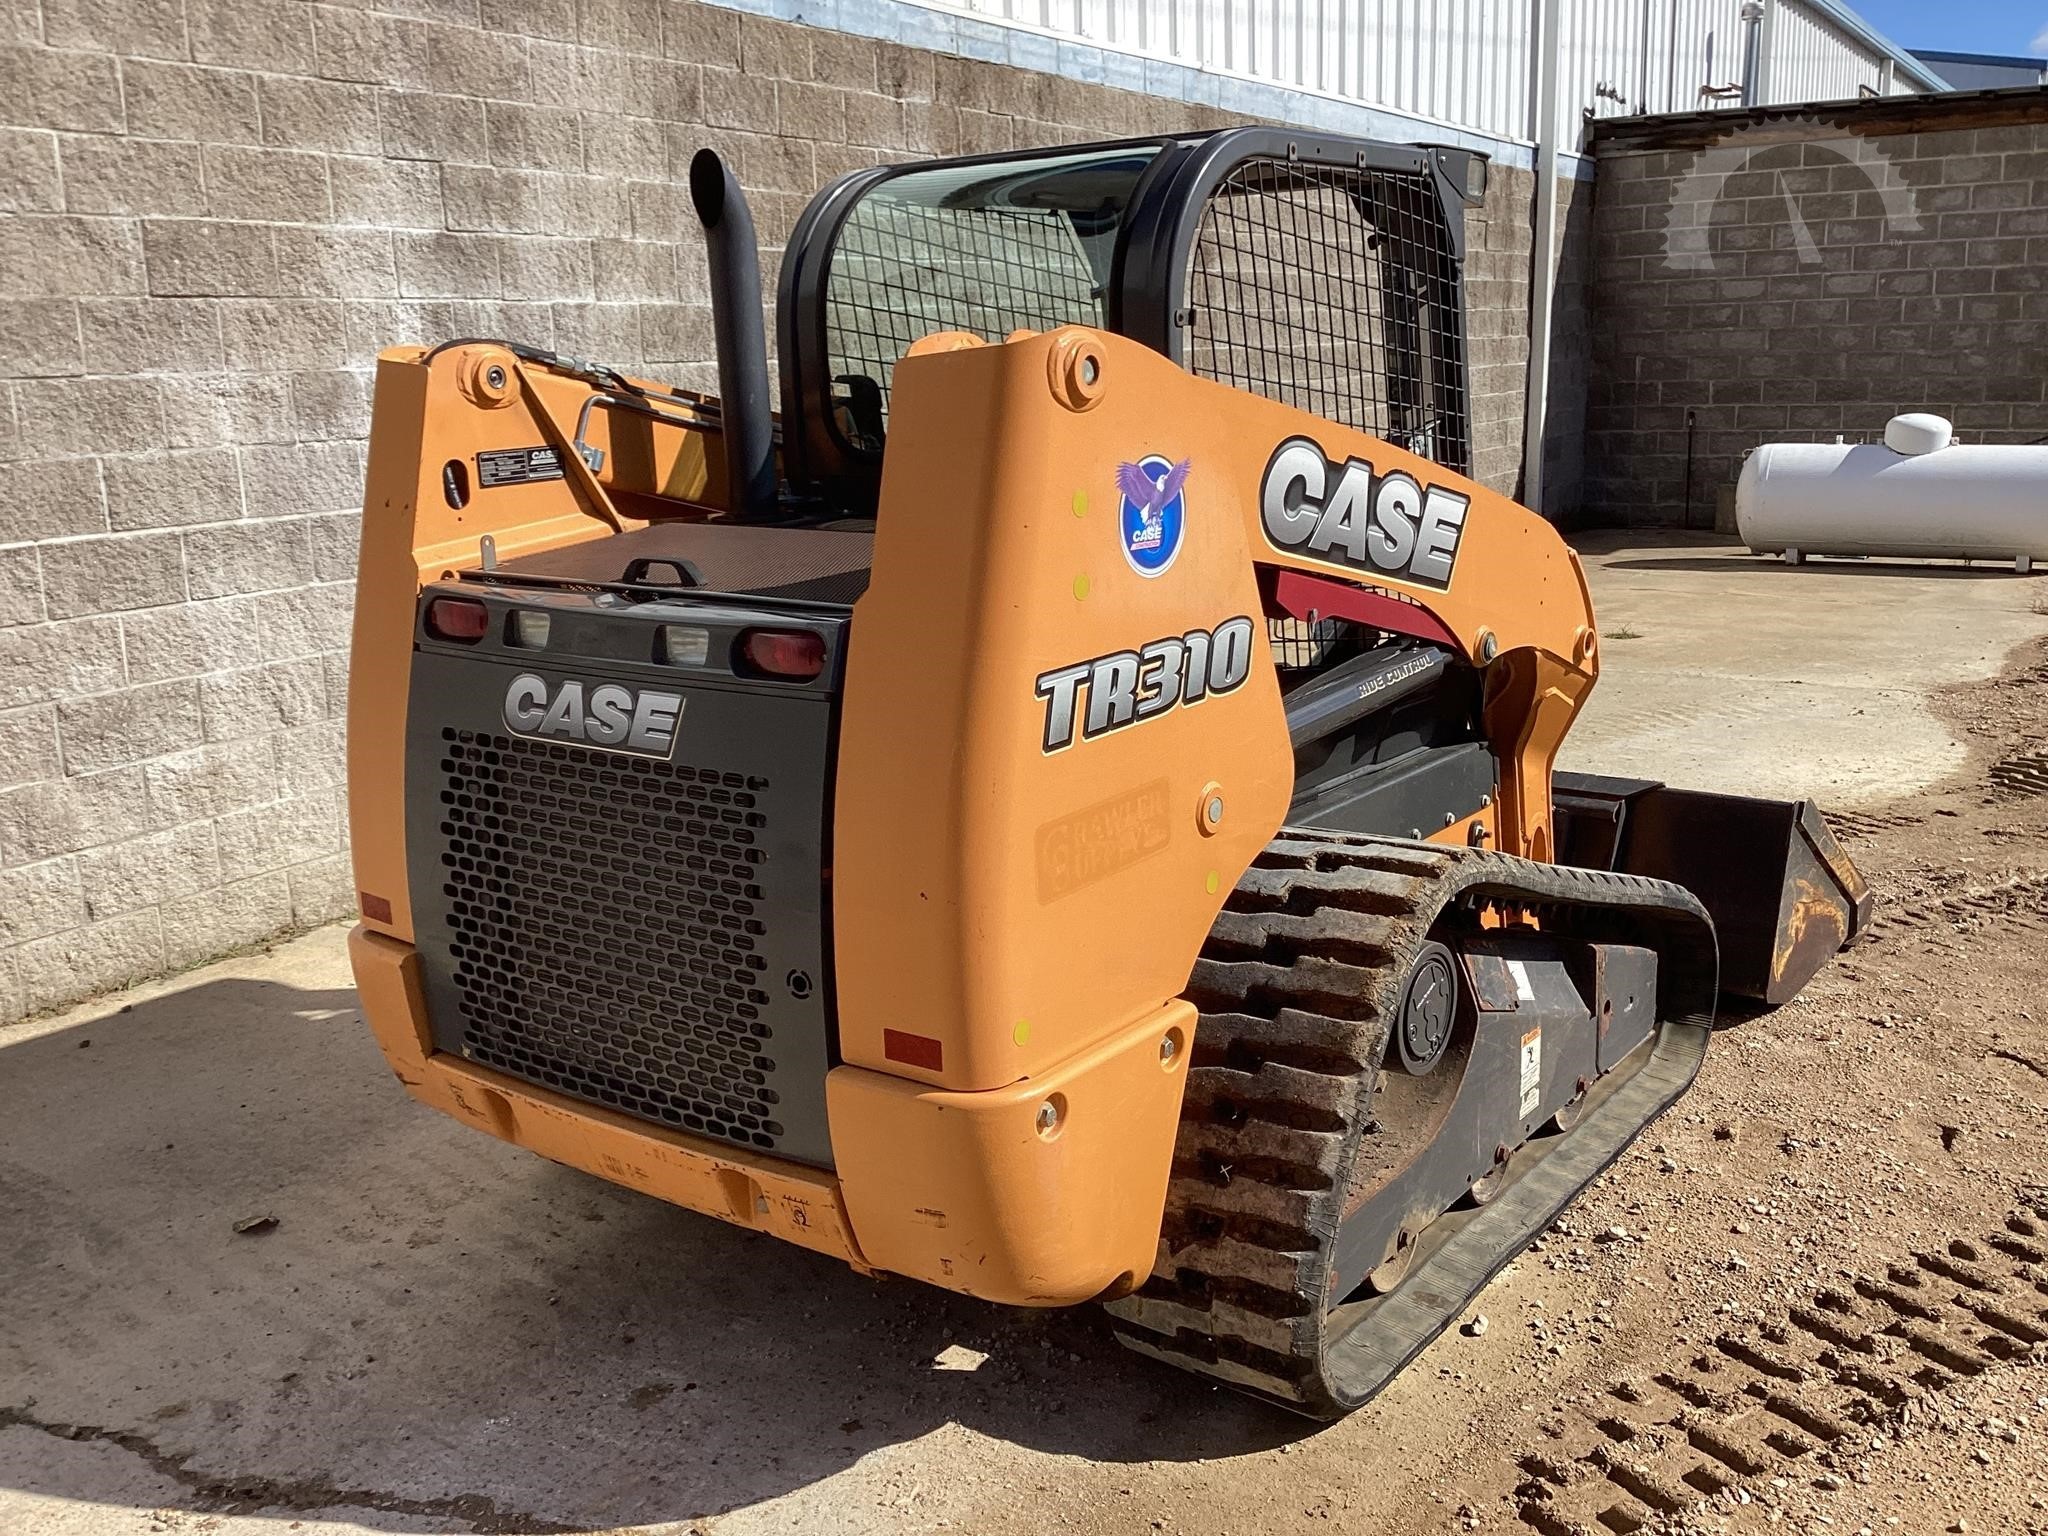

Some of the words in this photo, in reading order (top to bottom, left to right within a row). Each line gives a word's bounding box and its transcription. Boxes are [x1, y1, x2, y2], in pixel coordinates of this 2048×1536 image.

[1132, 525, 1162, 542] CASE
[1263, 437, 1471, 582] CASE
[1036, 616, 1254, 754] TR310
[1386, 654, 1434, 686] CONTROL
[504, 673, 684, 750] CASE
